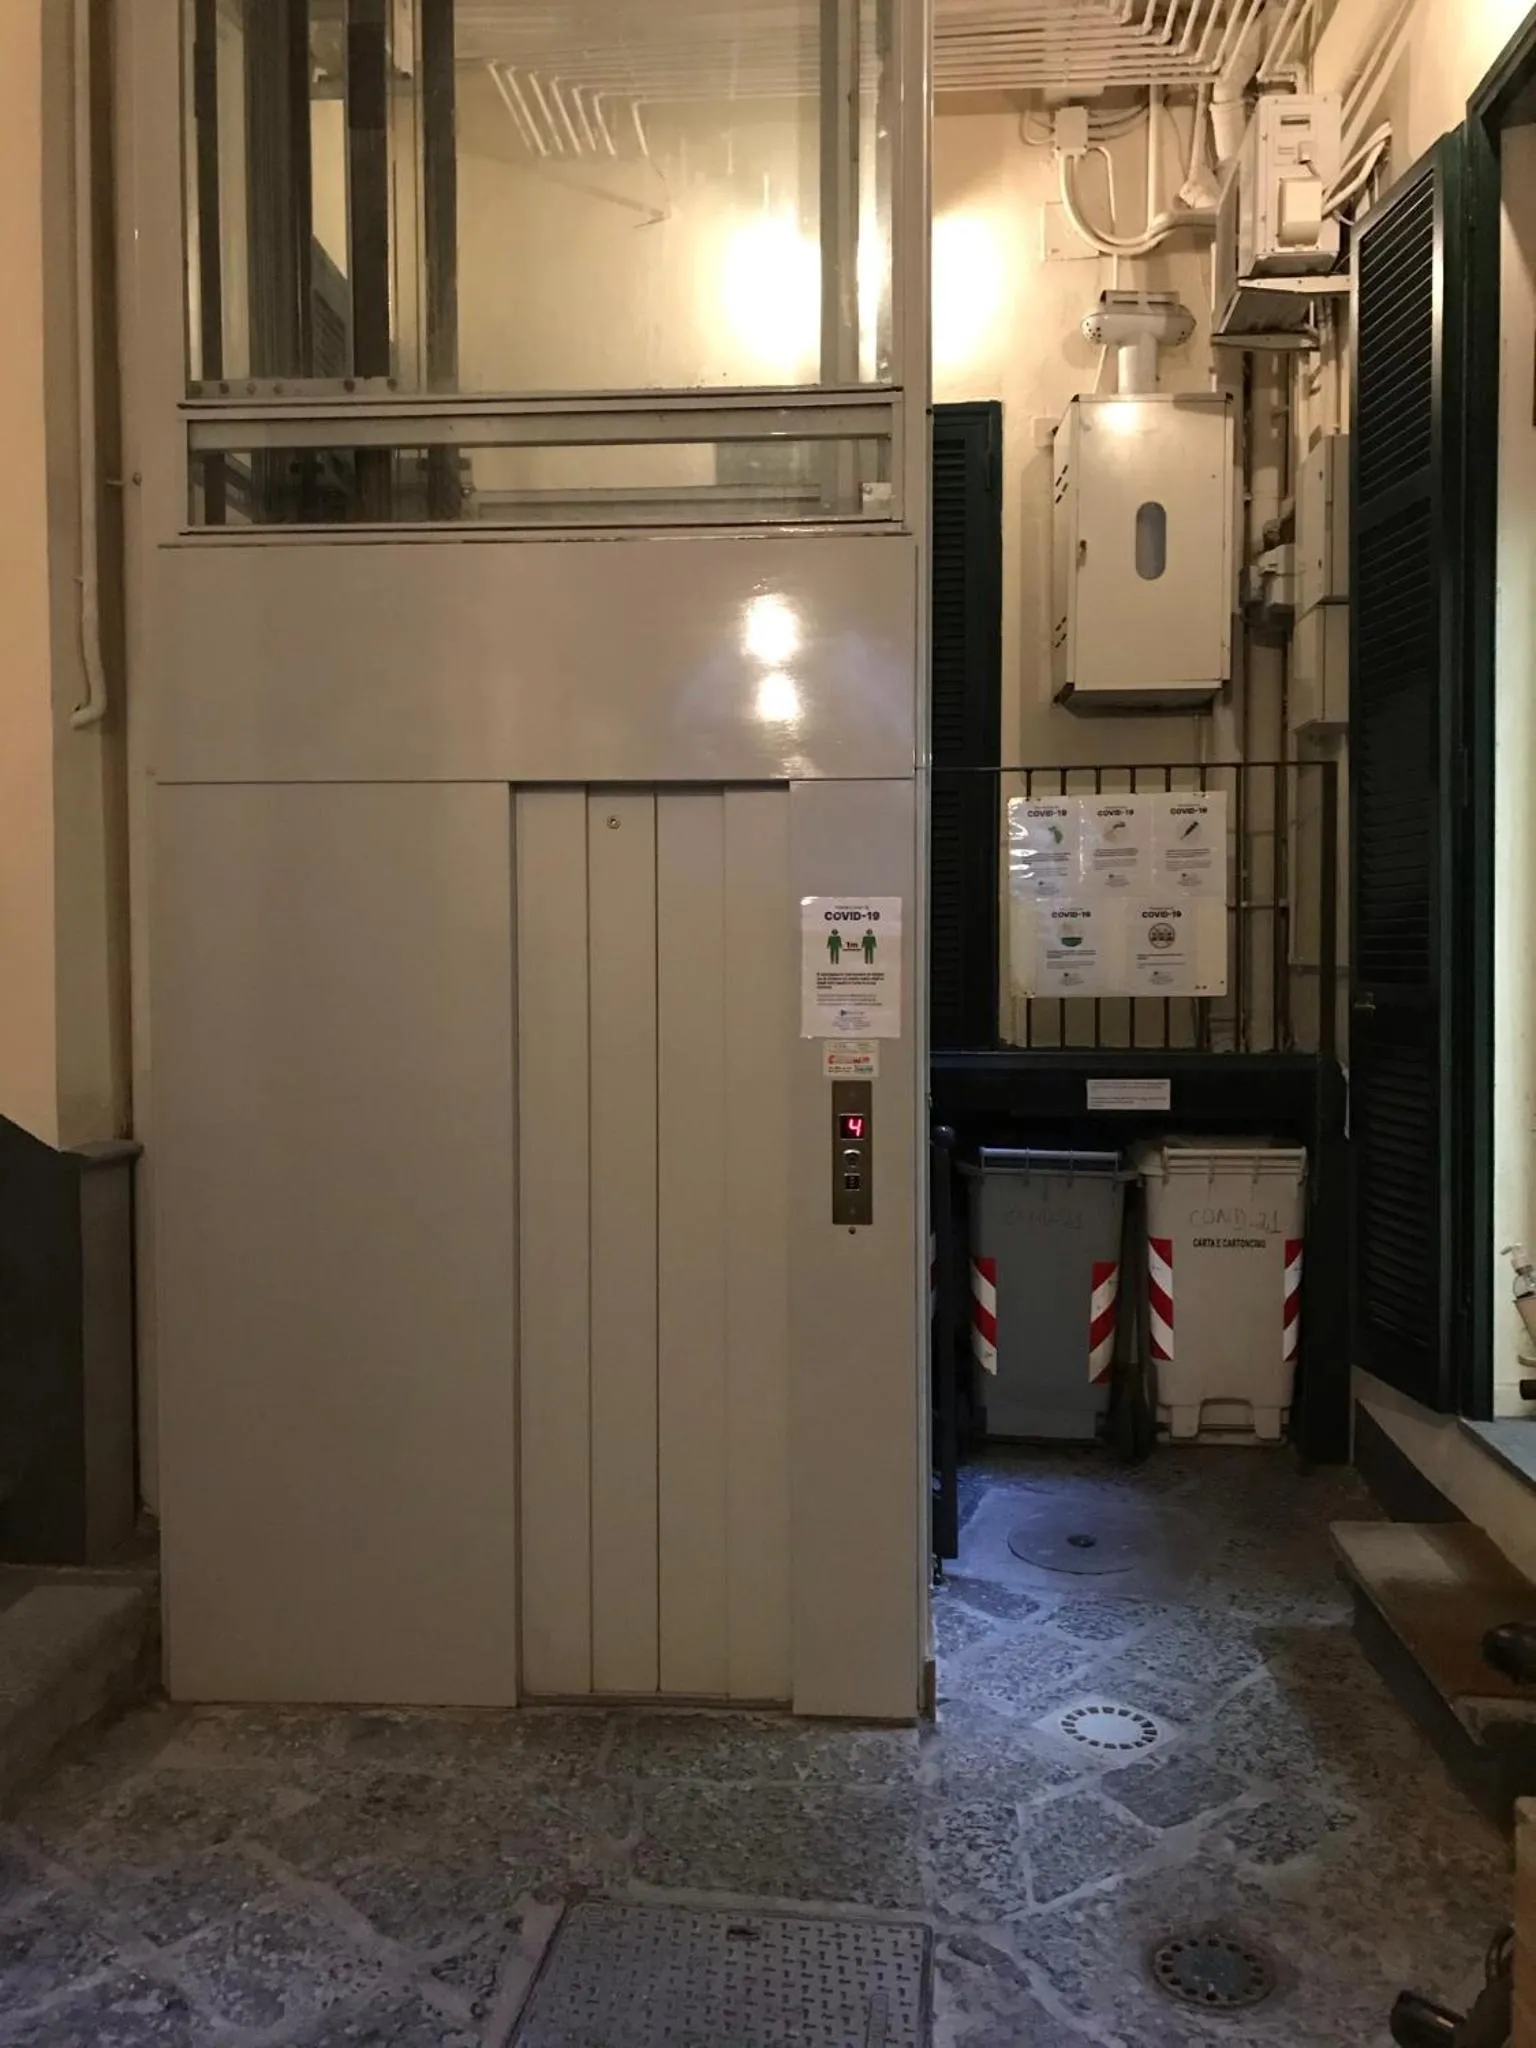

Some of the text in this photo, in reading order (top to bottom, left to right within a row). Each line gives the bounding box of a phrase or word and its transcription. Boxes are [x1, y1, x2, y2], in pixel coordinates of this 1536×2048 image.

[1027, 809, 1068, 817] COVID-19
[824, 911, 881, 921] COVID-19
[1141, 910, 1182, 918] COVID-19
[848, 1118, 862, 1137] 4
[1193, 1238, 1214, 1248] CARTA
